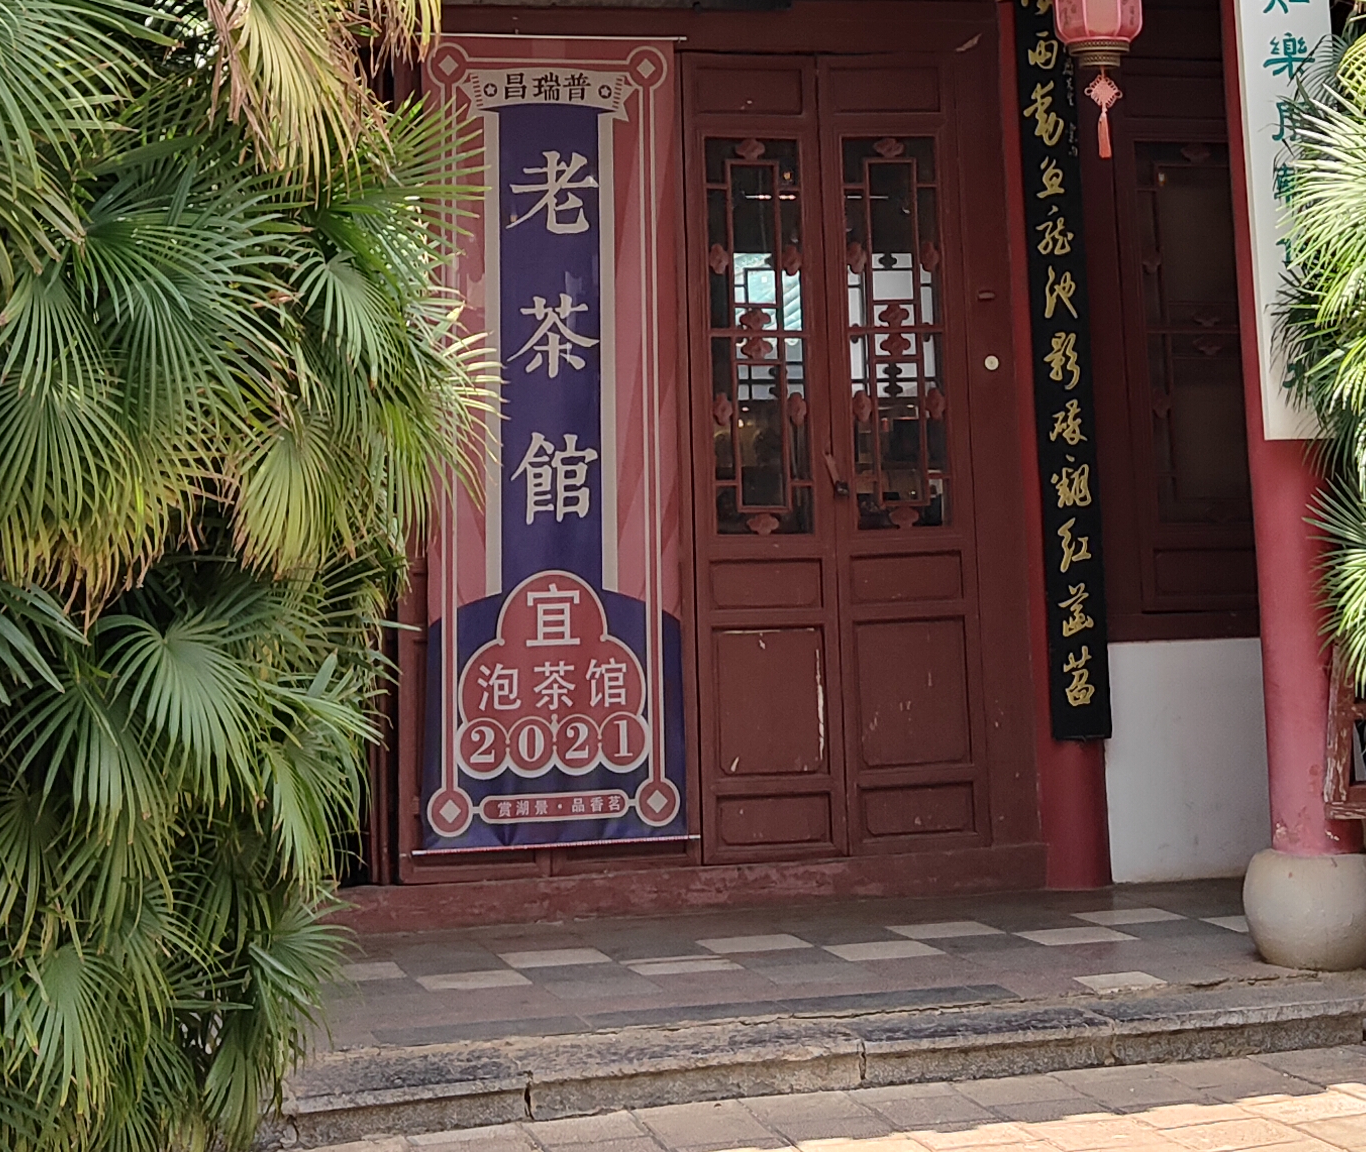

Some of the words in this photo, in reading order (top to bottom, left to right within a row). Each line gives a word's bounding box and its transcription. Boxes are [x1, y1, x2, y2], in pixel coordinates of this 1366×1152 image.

[506, 150, 600, 525] 老茶館
[526, 583, 580, 647] 宜
[477, 658, 628, 711] 泡茶馆
[470, 720, 633, 763] 2021
